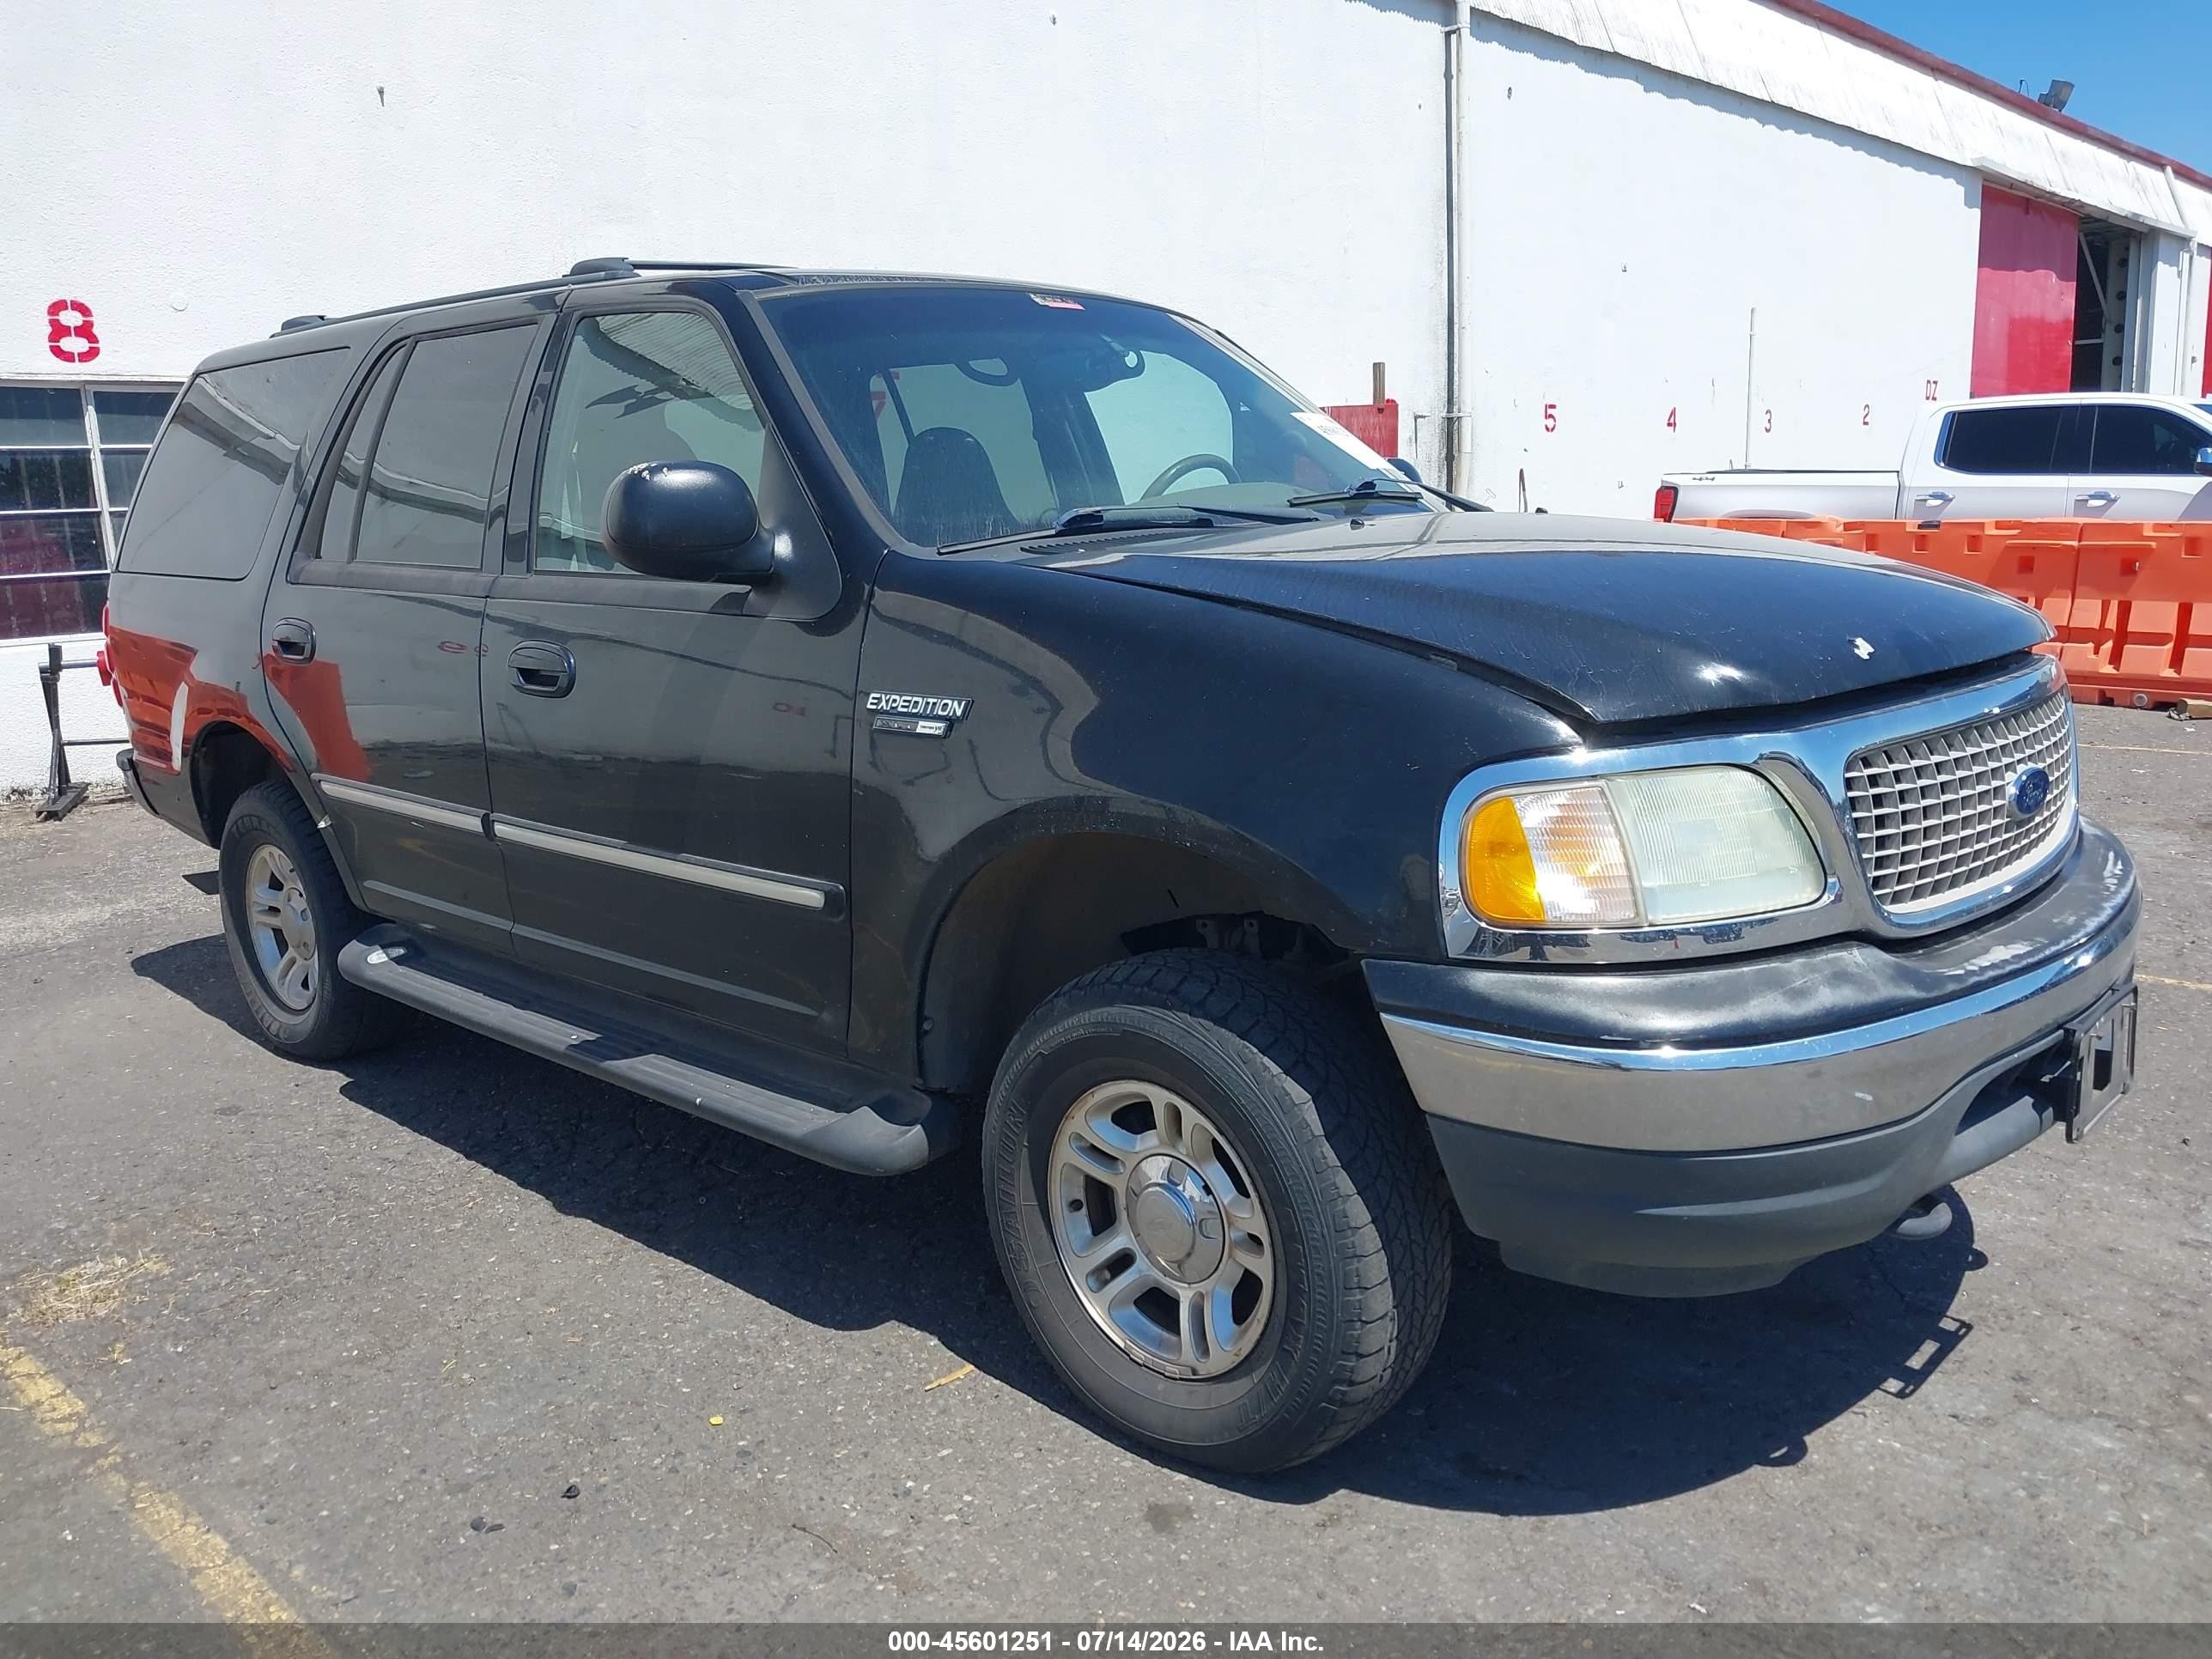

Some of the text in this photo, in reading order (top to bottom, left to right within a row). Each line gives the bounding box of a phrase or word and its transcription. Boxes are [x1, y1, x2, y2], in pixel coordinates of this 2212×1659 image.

[46, 298, 101, 363] 8
[1925, 380, 1938, 401] DZ
[1544, 403, 1557, 433] 5
[1666, 407, 1677, 433] 4
[1765, 409, 1772, 433] 3
[1863, 404, 1870, 426] 2
[866, 693, 966, 717] EXPEDITION
